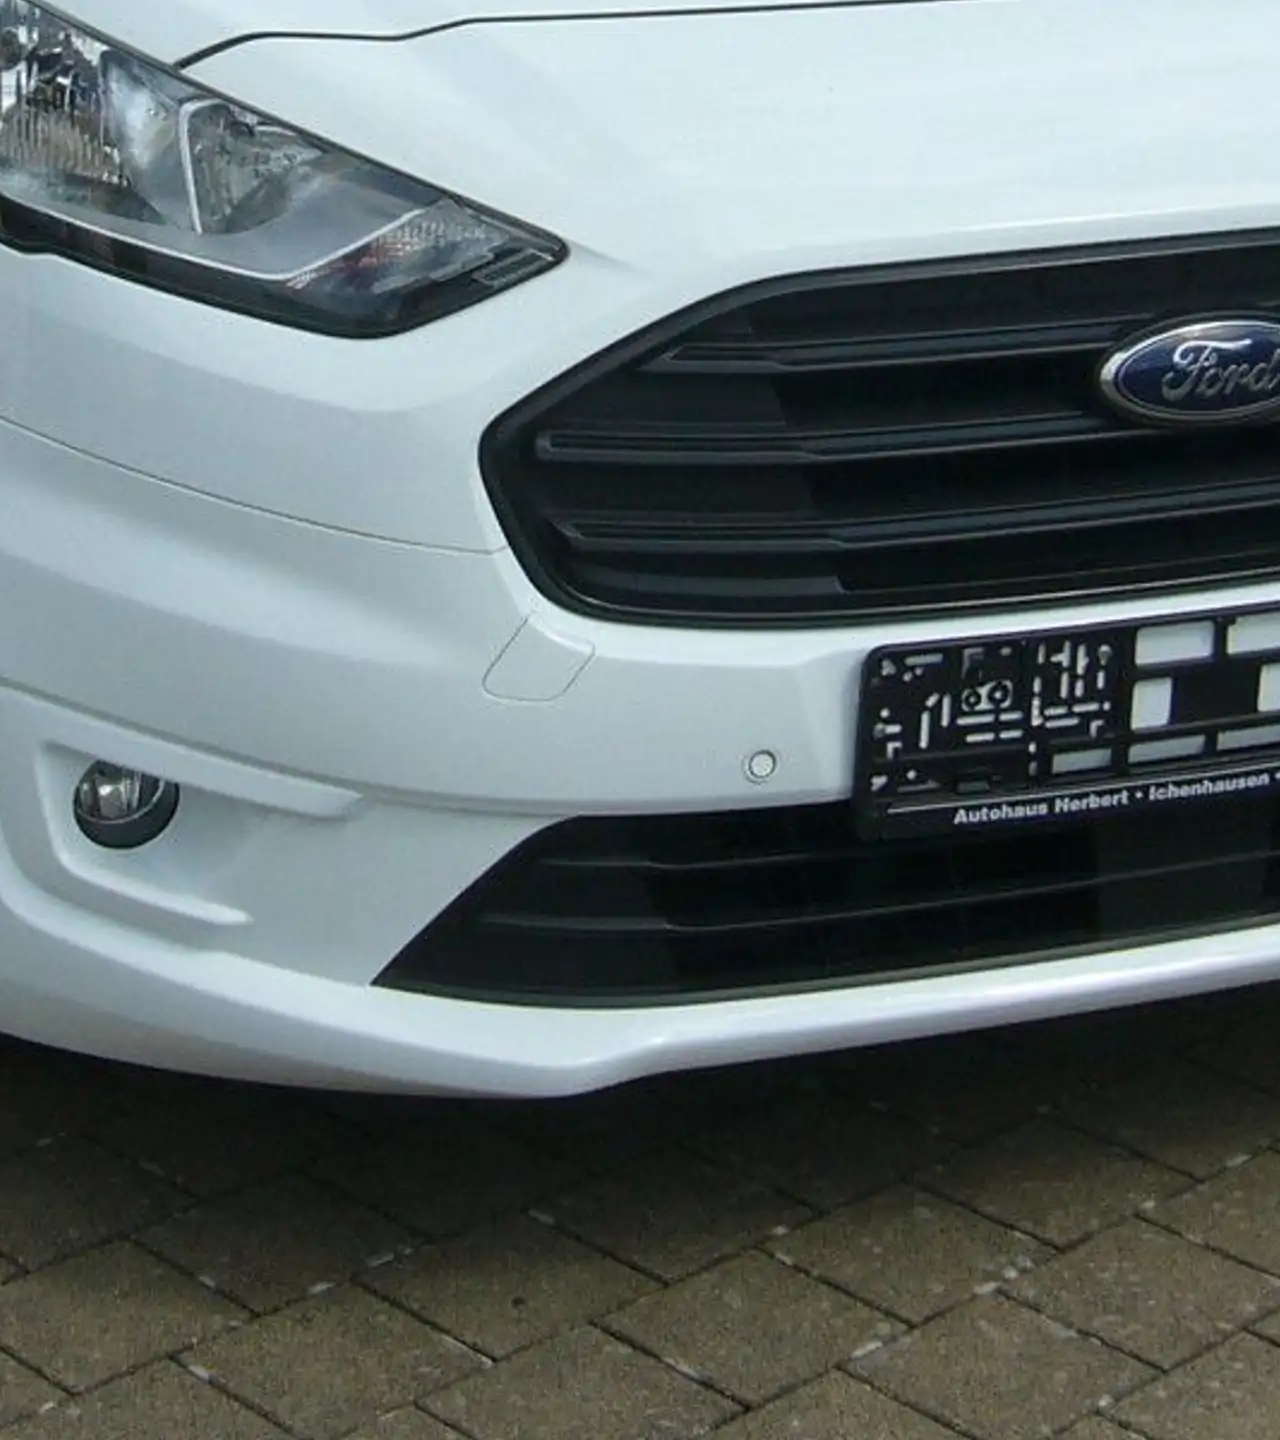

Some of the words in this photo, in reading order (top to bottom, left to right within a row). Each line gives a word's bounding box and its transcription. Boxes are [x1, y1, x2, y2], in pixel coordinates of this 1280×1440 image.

[953, 802, 1049, 825] Autohaus
[1054, 792, 1130, 814] Herbert
[1149, 771, 1270, 801] Ichenhausen
